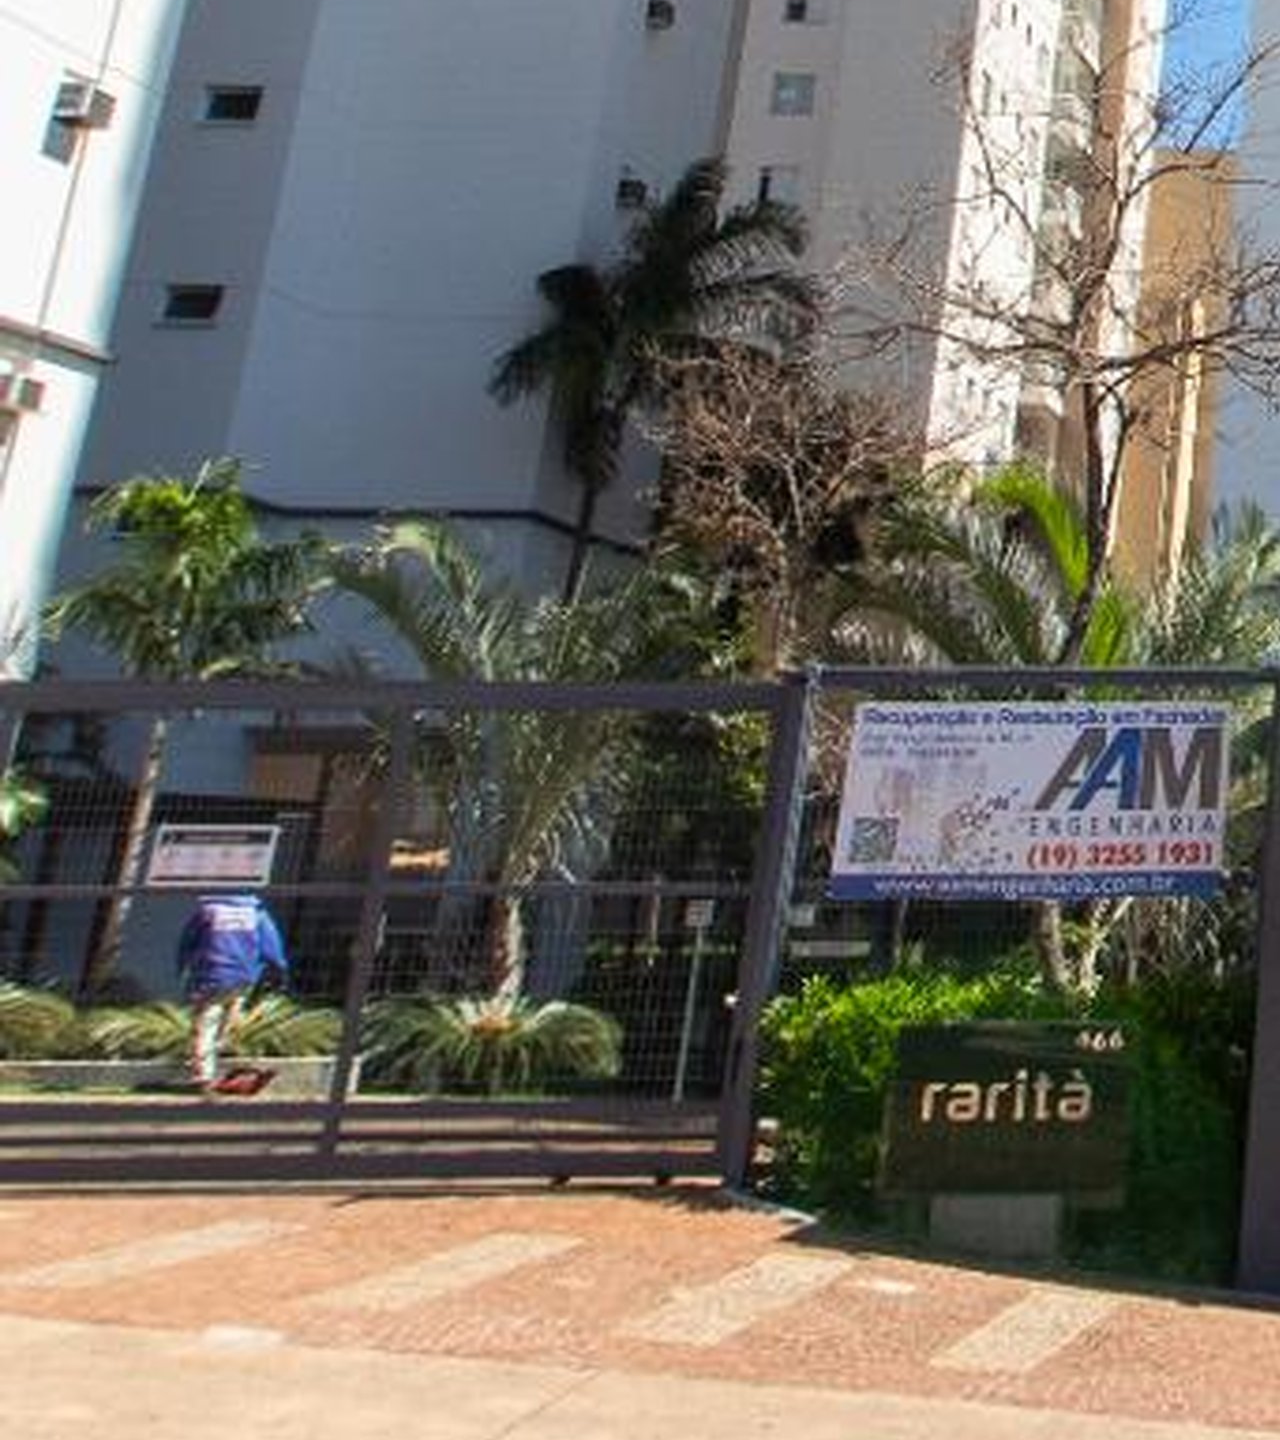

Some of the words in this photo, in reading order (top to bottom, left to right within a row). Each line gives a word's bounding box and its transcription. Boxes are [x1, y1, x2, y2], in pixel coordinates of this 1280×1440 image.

[1035, 727, 1224, 811] AAM
[1028, 814, 1218, 837] ENGENHARIA
[1027, 841, 1077, 870] (19)
[1086, 842, 1147, 867] 3255
[1156, 841, 1215, 866] 1931
